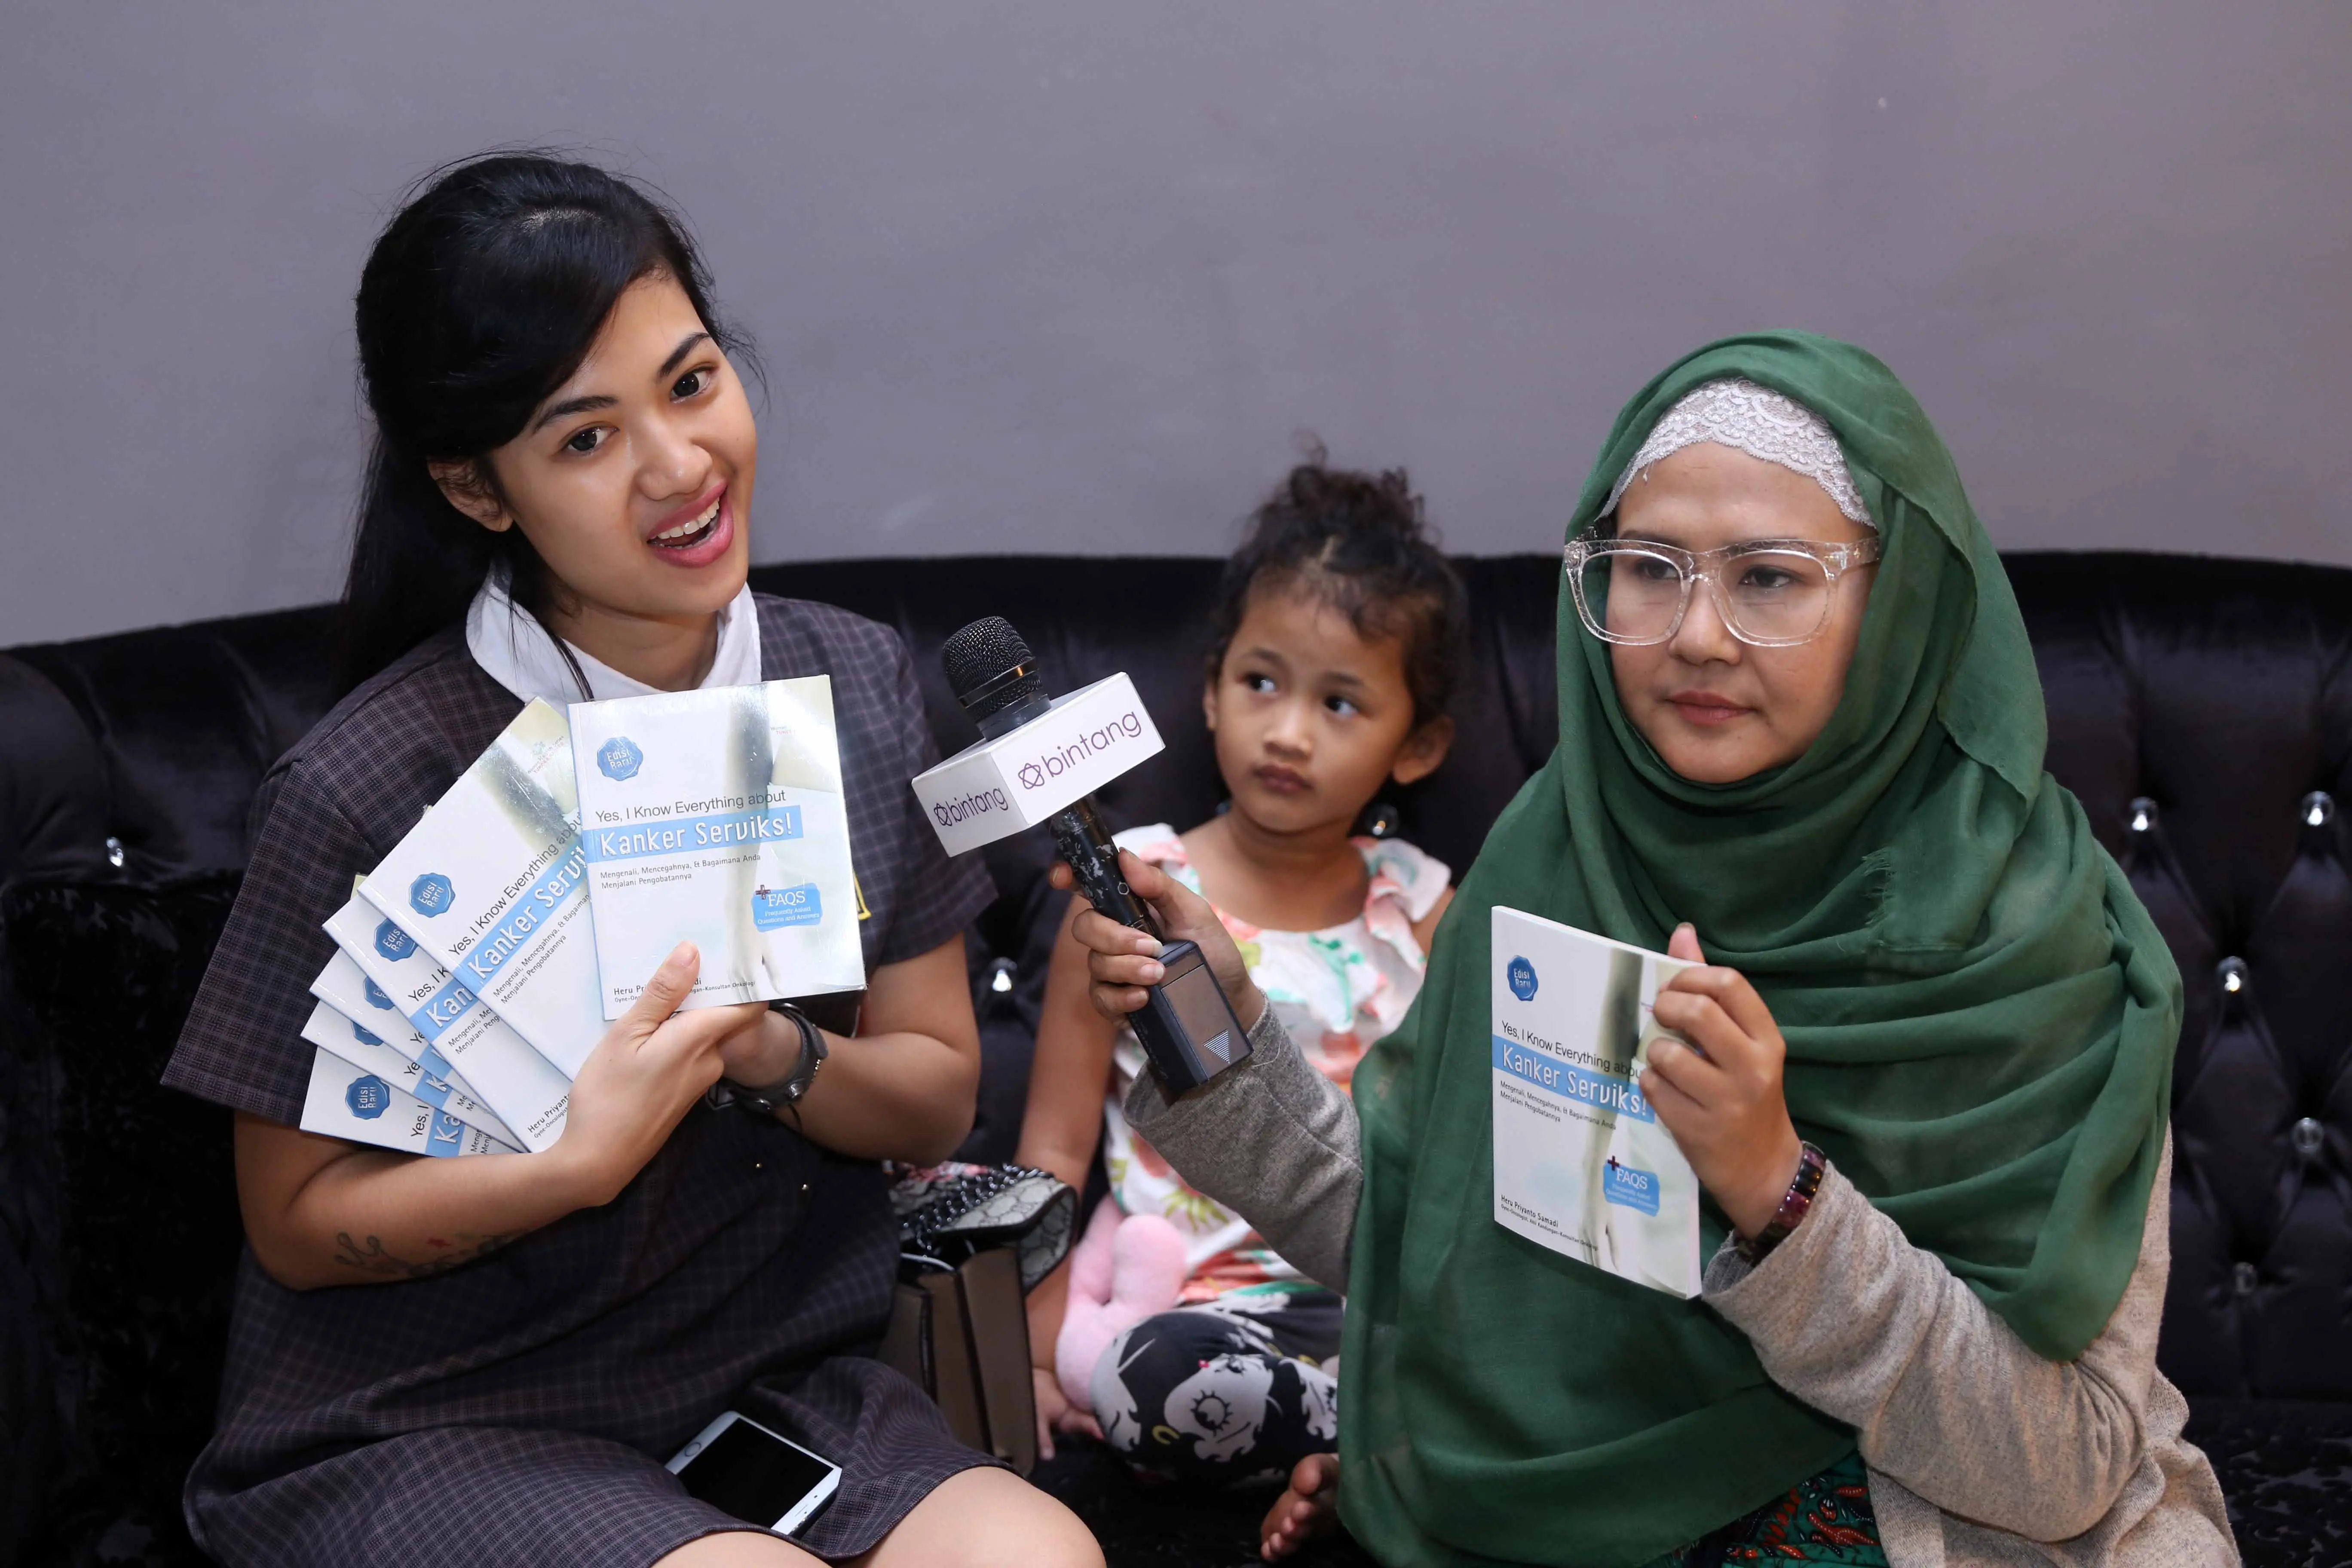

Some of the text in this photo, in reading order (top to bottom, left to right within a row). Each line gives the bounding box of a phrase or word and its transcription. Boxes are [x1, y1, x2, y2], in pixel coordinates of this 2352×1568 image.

[1041, 711, 1142, 777] bintang
[595, 790, 786, 822] Yes, I Know Everything about
[946, 786, 1009, 824] bintang
[600, 827, 686, 857] Kanker
[600, 868, 639, 879] Mengenali,
[641, 862, 692, 874] Mencegahnya,
[702, 857, 741, 867] Bagaimana
[743, 854, 761, 862] Anda
[601, 873, 692, 889] Menjalani Pengobatannya
[418, 880, 437, 903] Edisi
[448, 934, 476, 956] Yes,
[470, 925, 479, 936] I
[475, 897, 507, 929] Know
[504, 843, 559, 899] Everything
[767, 890, 805, 907] FAQS
[467, 905, 538, 980] Kanker
[493, 966, 524, 997] Mengenali,
[521, 928, 560, 967] Mencegahnya,
[501, 934, 567, 1004] Menjalani Pengobatannya
[1514, 968, 1530, 979] Edisi
[408, 974, 440, 1001] Yes, I
[614, 985, 633, 995] Heru
[448, 1018, 481, 1047] Mengenali,
[455, 1028, 485, 1054] Menjalani
[1502, 1020, 1519, 1040] Yes,
[1522, 1029, 1524, 1041] I
[1527, 1031, 1553, 1051] Know
[1556, 1042, 1610, 1072] Everything
[1502, 1044, 1560, 1088] Kanker
[358, 1086, 368, 1108] Edisi
[1500, 1080, 1525, 1098] Mengenali,
[1527, 1092, 1562, 1112] Mencegahnya,
[1569, 1109, 1600, 1125] Bagaimana
[1602, 1119, 1616, 1130] Anda
[1500, 1090, 1561, 1122] Menjalani Pengobatannya
[410, 1113, 429, 1136] Yes,
[527, 1093, 569, 1133] Heru Priyant
[1616, 1167, 1648, 1190] FAQS
[1501, 1194, 1558, 1228] Heru Priyanto Samadi
